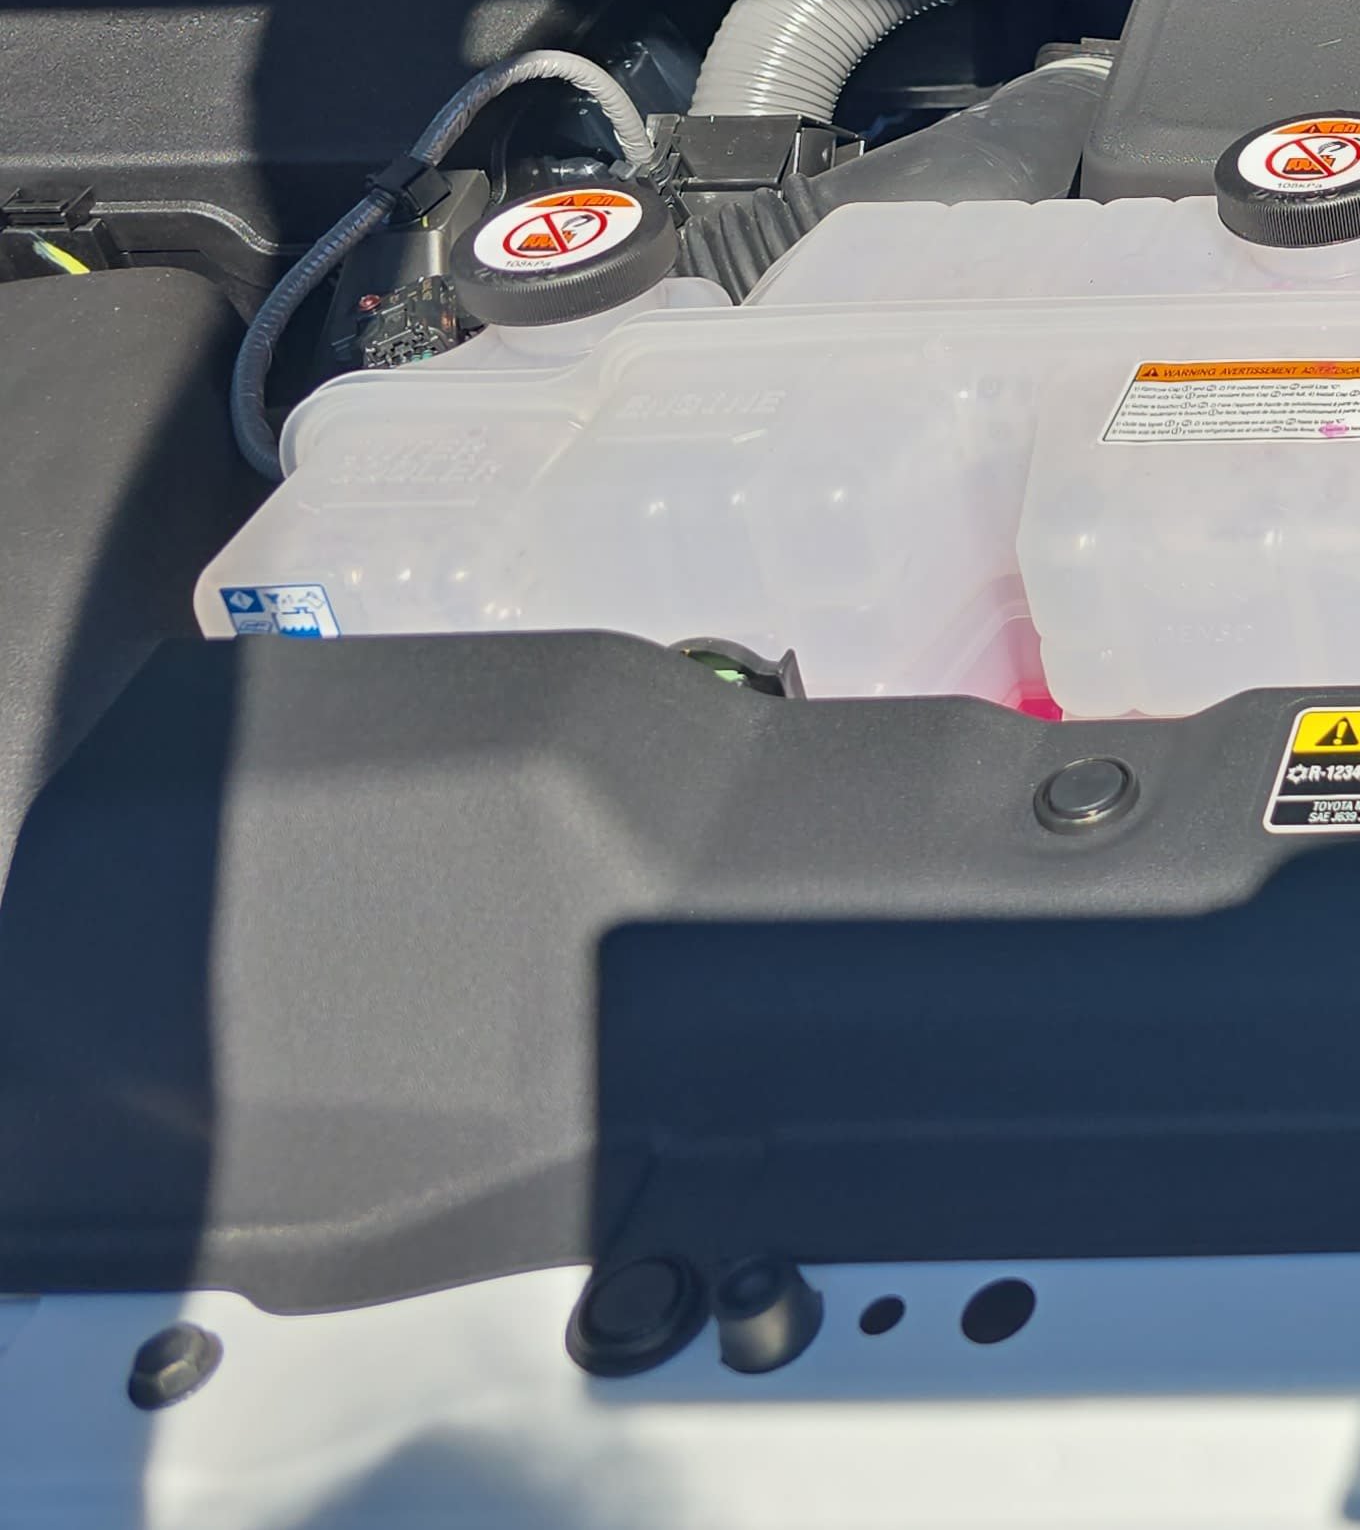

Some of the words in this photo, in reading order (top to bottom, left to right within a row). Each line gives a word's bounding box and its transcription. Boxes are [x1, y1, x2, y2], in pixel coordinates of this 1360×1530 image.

[1163, 368, 1216, 378] WARNING
[1220, 366, 1297, 376] AVERTISSEMENT
[1312, 800, 1354, 812] TOYOTA
[1307, 811, 1331, 823] SAE
